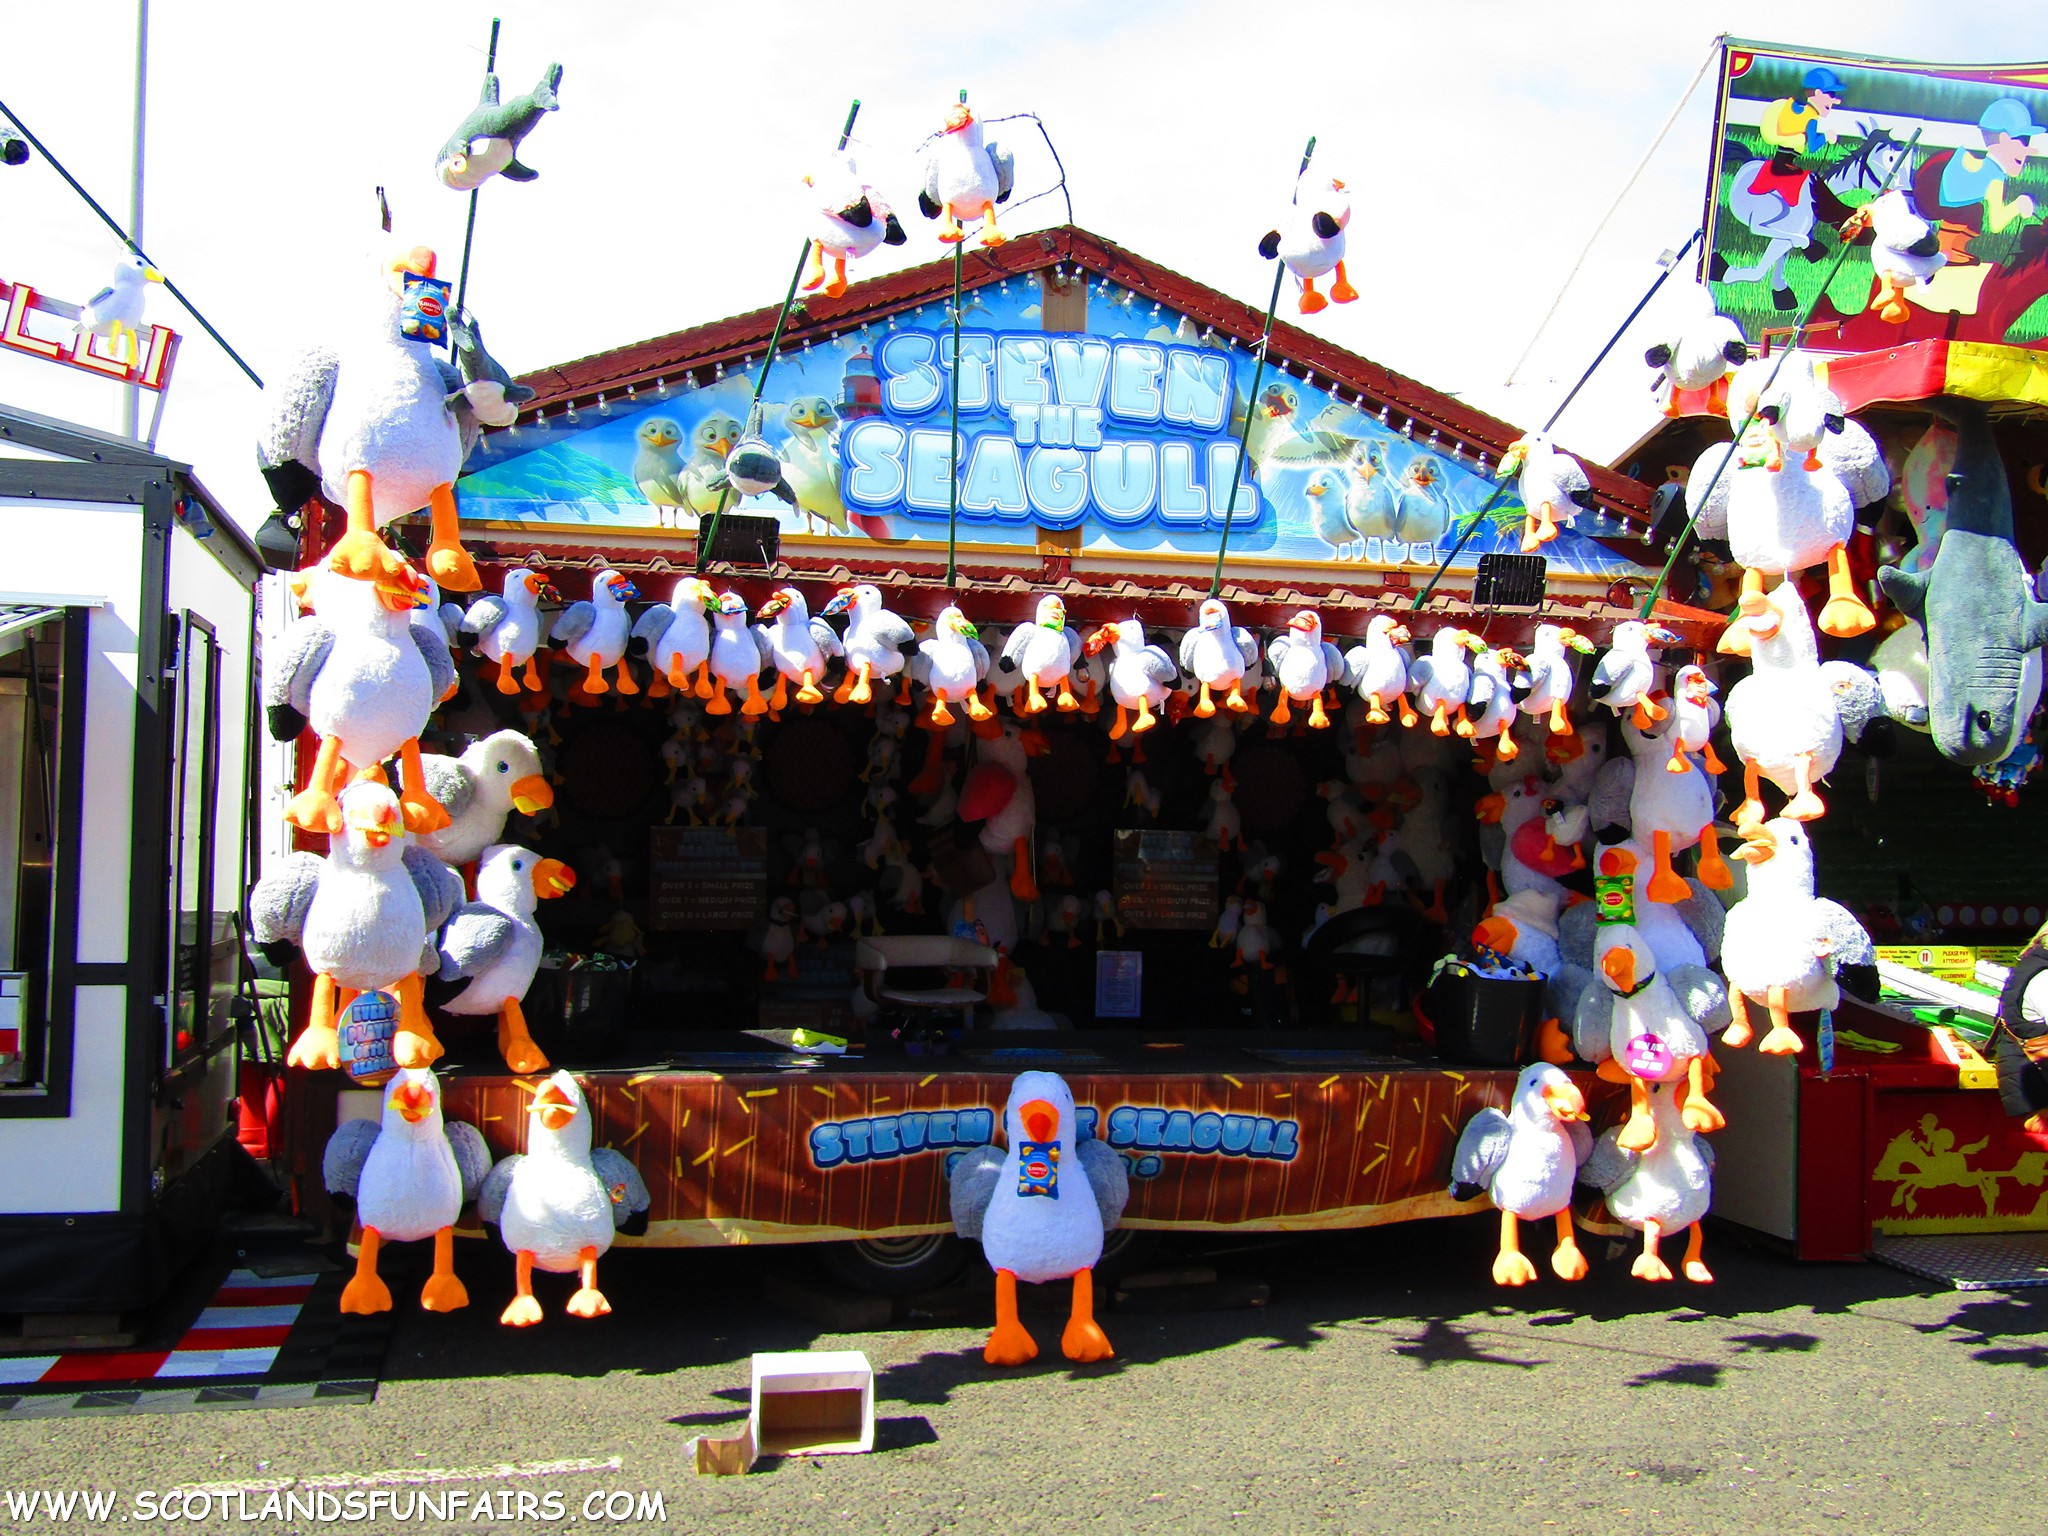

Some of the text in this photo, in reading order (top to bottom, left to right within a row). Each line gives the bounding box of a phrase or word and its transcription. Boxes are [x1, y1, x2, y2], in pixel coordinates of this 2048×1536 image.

[0, 278, 176, 389] LLI
[880, 330, 1233, 429] STEVEN
[1009, 402, 1103, 448] THE
[846, 421, 1260, 524] SEAGULL
[661, 881, 685, 890] OVER
[701, 881, 729, 890] SMALL
[731, 881, 755, 890] PRIZE
[1124, 882, 1144, 890] OVER
[1160, 883, 1184, 891] SMALL
[1186, 884, 1208, 892] PRIZE
[658, 896, 682, 904] OVER
[697, 896, 733, 904] MEDIUM
[735, 896, 758, 904] PRIZE
[1156, 897, 1188, 905] MEDIUM
[1189, 897, 1211, 905] PRIZE
[661, 911, 685, 919] OVER
[702, 911, 728, 919] LARGE
[731, 911, 755, 919] PRIZE
[1124, 910, 1144, 918] OVER
[1160, 911, 1185, 919] LARGE
[1187, 911, 1208, 919] PRIZE
[352, 1002, 395, 1023] EVERY
[811, 1109, 994, 1167] STEVEN
[1108, 1106, 1299, 1161] SEAGULL
